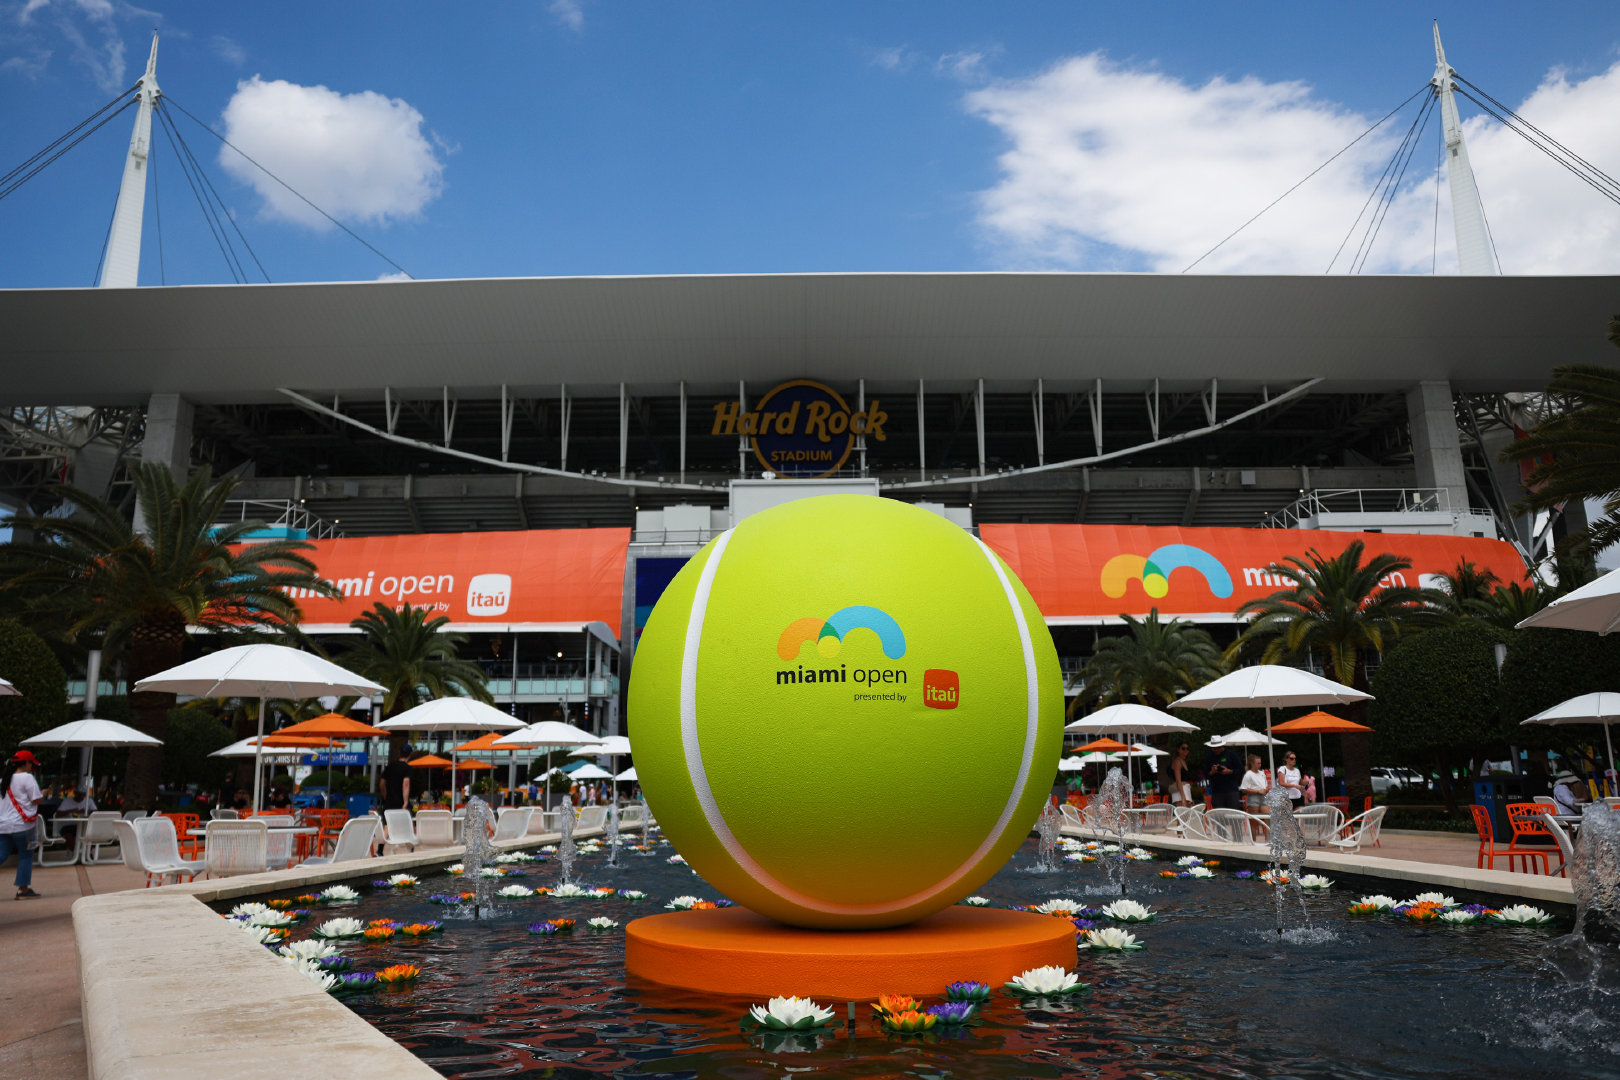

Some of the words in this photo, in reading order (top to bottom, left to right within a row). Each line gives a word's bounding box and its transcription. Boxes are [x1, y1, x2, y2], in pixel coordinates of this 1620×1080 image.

[711, 401, 801, 435] Hard
[805, 399, 889, 442] Rock
[770, 450, 833, 462] STADIUM
[379, 573, 454, 601] open
[439, 602, 450, 612] by
[776, 663, 846, 685] miami
[853, 669, 907, 687] open
[854, 692, 896, 701] presented
[897, 692, 907, 703] by
